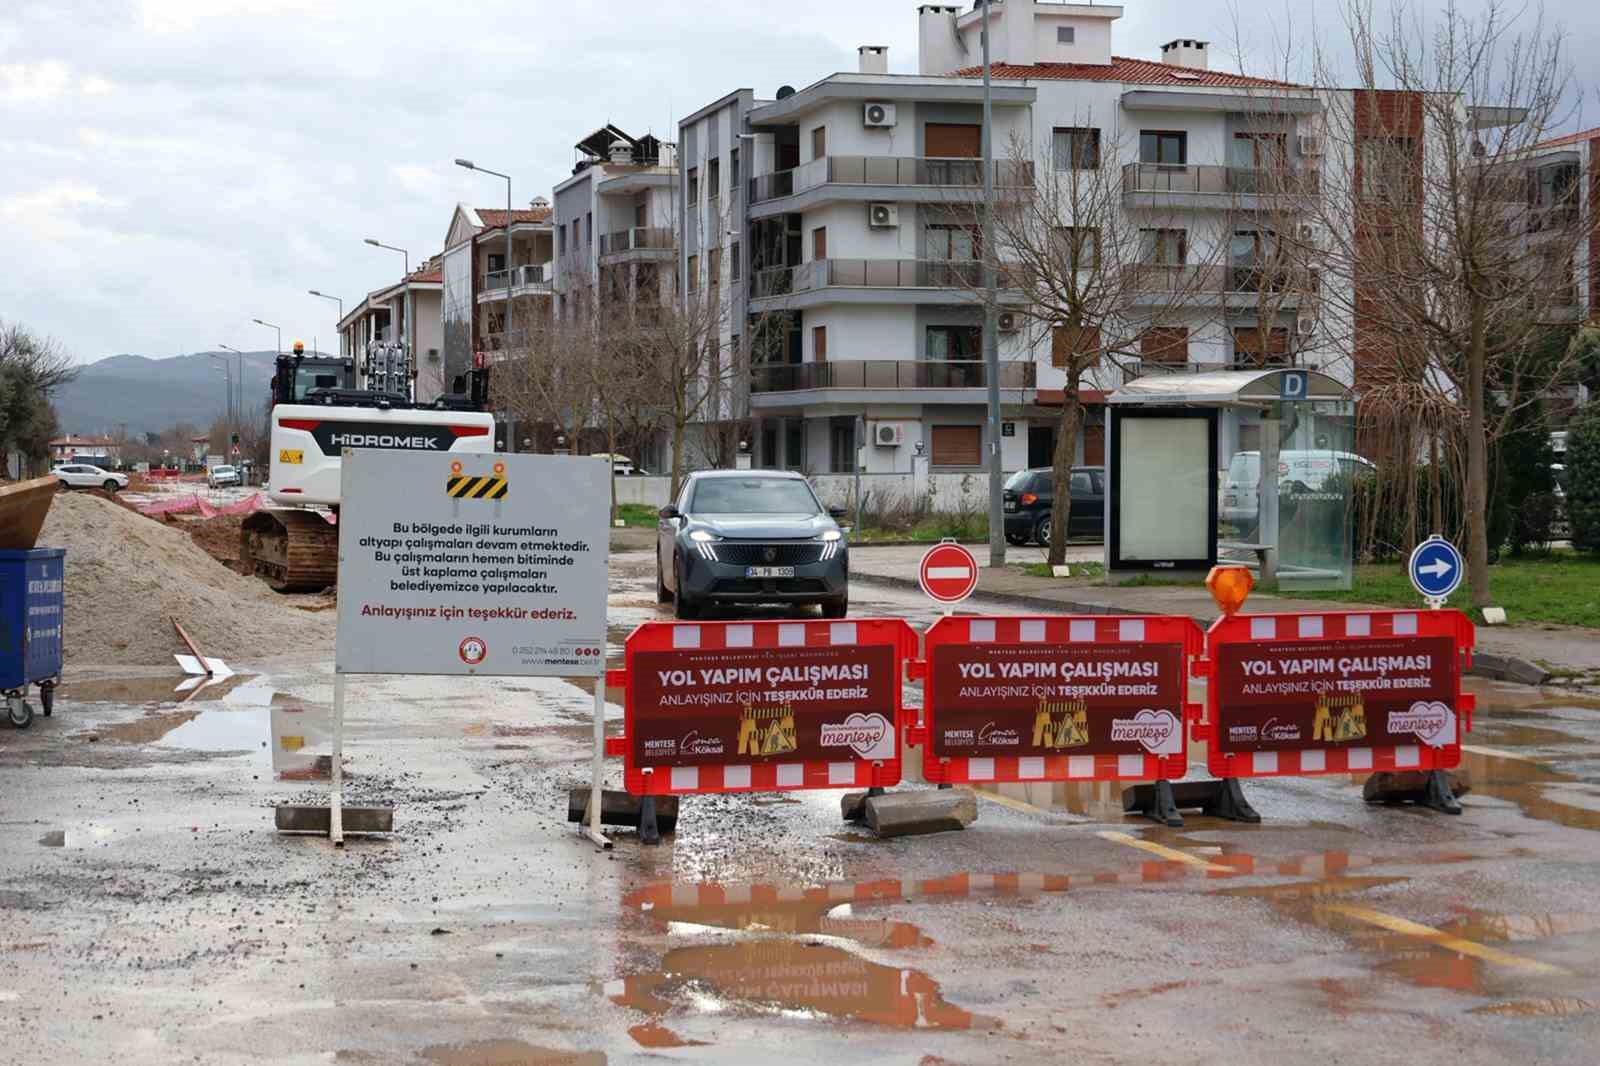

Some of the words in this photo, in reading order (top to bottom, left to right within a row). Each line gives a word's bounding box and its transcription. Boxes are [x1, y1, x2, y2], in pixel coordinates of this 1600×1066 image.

[1285, 373, 1303, 396] D
[393, 522, 409, 533] Bu
[412, 522, 463, 537] bölgede
[466, 524, 490, 537] ilgili
[493, 525, 558, 537] kurumların
[359, 536, 402, 549] altyapı
[405, 538, 472, 551] çalışmaları
[476, 539, 517, 550] devam
[520, 541, 590, 552] etmektedir.
[375, 551, 391, 562] Bu
[393, 552, 469, 565] çalışmaların
[472, 553, 515, 564] hemen
[517, 554, 574, 566] bitiminde
[401, 566, 420, 577] üst
[423, 567, 478, 580] kaplama
[480, 568, 547, 581] çalışmaları
[390, 580, 480, 593] belediyemizce
[482, 582, 558, 595] yapılacaktır.
[361, 604, 437, 621] Anlayışınız
[440, 605, 464, 621] için
[468, 606, 528, 622] teşekkür
[530, 607, 577, 620] ederiz.
[958, 663, 994, 678] YOL
[999, 662, 1057, 677] YAPIM
[1060, 662, 1159, 682] ÇALIŞMASI
[1241, 660, 1276, 676] YOL
[1279, 658, 1335, 674] YAPIM
[1338, 655, 1431, 678] ÇALIŞMASI
[658, 670, 696, 686] YOL
[700, 668, 761, 685] YAPIM
[766, 664, 869, 688] ÇALIŞMASI
[1242, 680, 1309, 695] ANLAYIŞINIZ
[1311, 680, 1334, 695] İÇİN
[1335, 676, 1391, 693] TEŞEKKÜR
[1393, 674, 1431, 688] EDERİZ
[659, 690, 733, 707] ANLAYIŞINIZ
[736, 688, 761, 705] İÇİN
[764, 686, 824, 704] TEŞEKKÜR
[827, 685, 869, 700] EDERİZ
[959, 685, 1029, 700] ANLAYIŞINIZ
[1031, 684, 1056, 699] İÇİN
[1058, 684, 1115, 699] TEŞEKKÜR
[1118, 682, 1158, 695] EDERİZ
